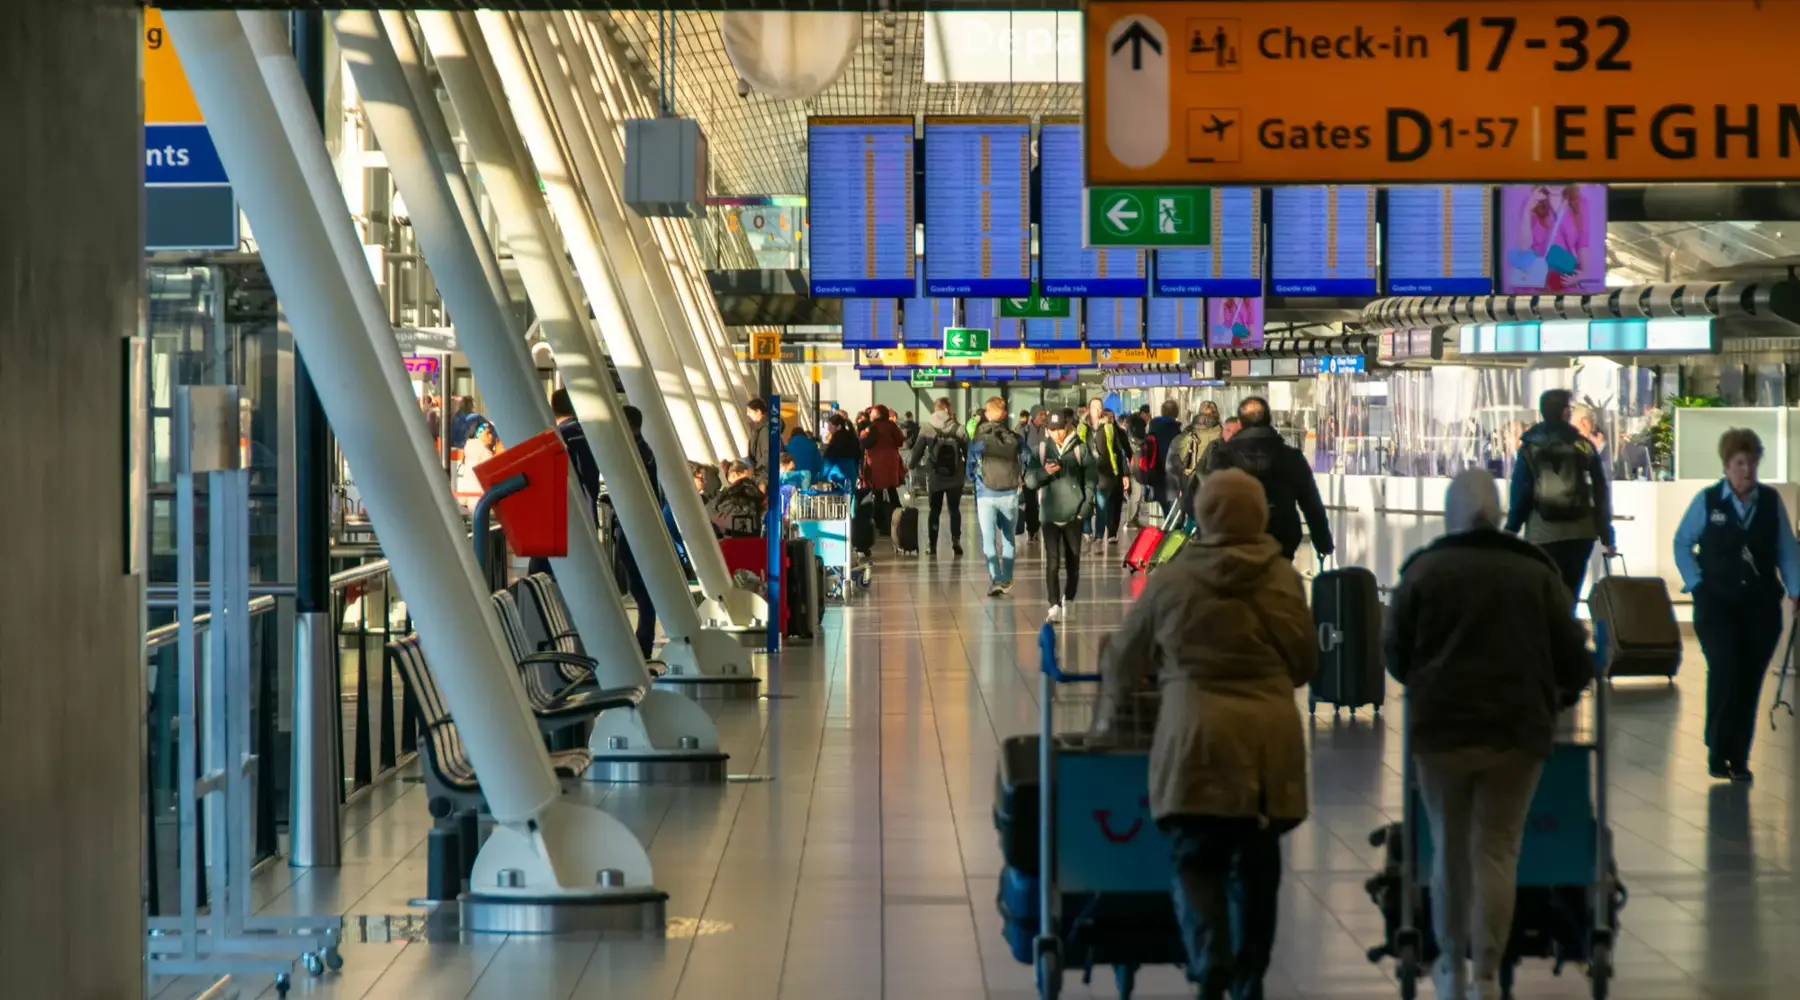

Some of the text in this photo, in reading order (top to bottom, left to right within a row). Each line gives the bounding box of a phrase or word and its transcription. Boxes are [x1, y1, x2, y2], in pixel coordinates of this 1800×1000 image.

[1258, 15, 1633, 72] Check-in 17-32
[1258, 118, 1371, 150] Gates
